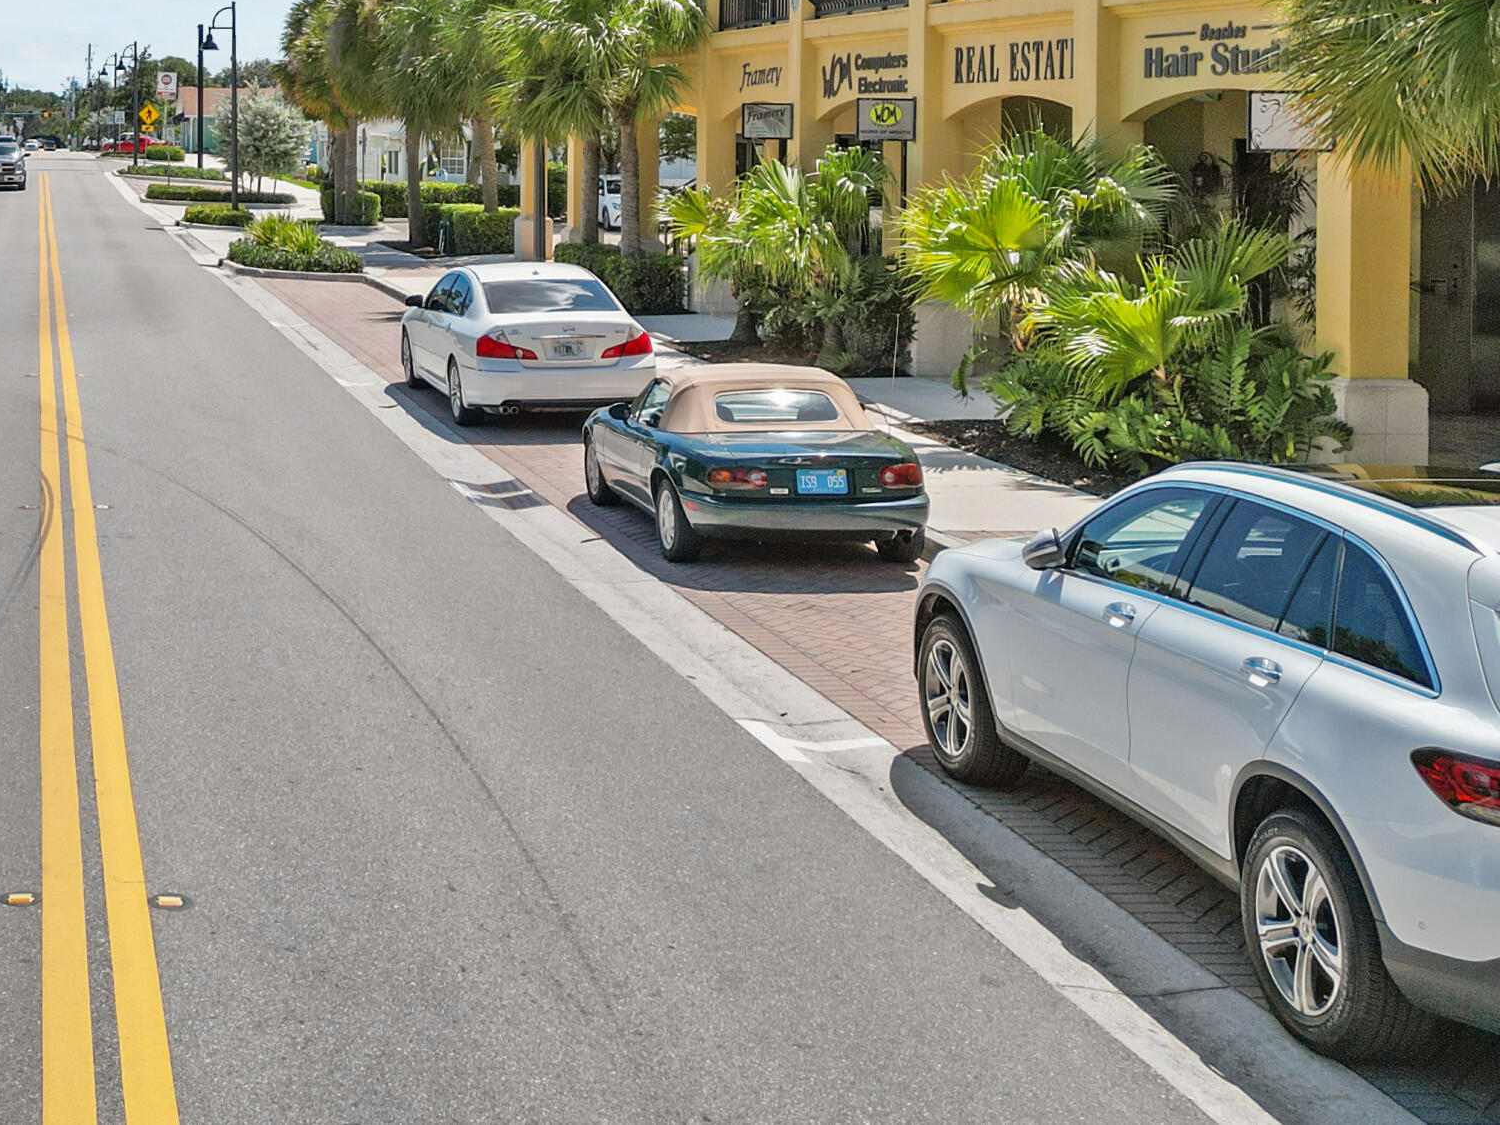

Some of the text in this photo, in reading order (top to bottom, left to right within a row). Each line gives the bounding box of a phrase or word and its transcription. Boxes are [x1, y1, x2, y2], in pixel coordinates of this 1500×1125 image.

[1200, 20, 1247, 41] Beaches
[855, 51, 908, 74] Computers
[954, 44, 999, 83] REAL
[1144, 38, 1290, 78] Hair Stud
[740, 62, 782, 93] Framery
[858, 75, 908, 94] Electronic
[746, 107, 786, 124] Framery
